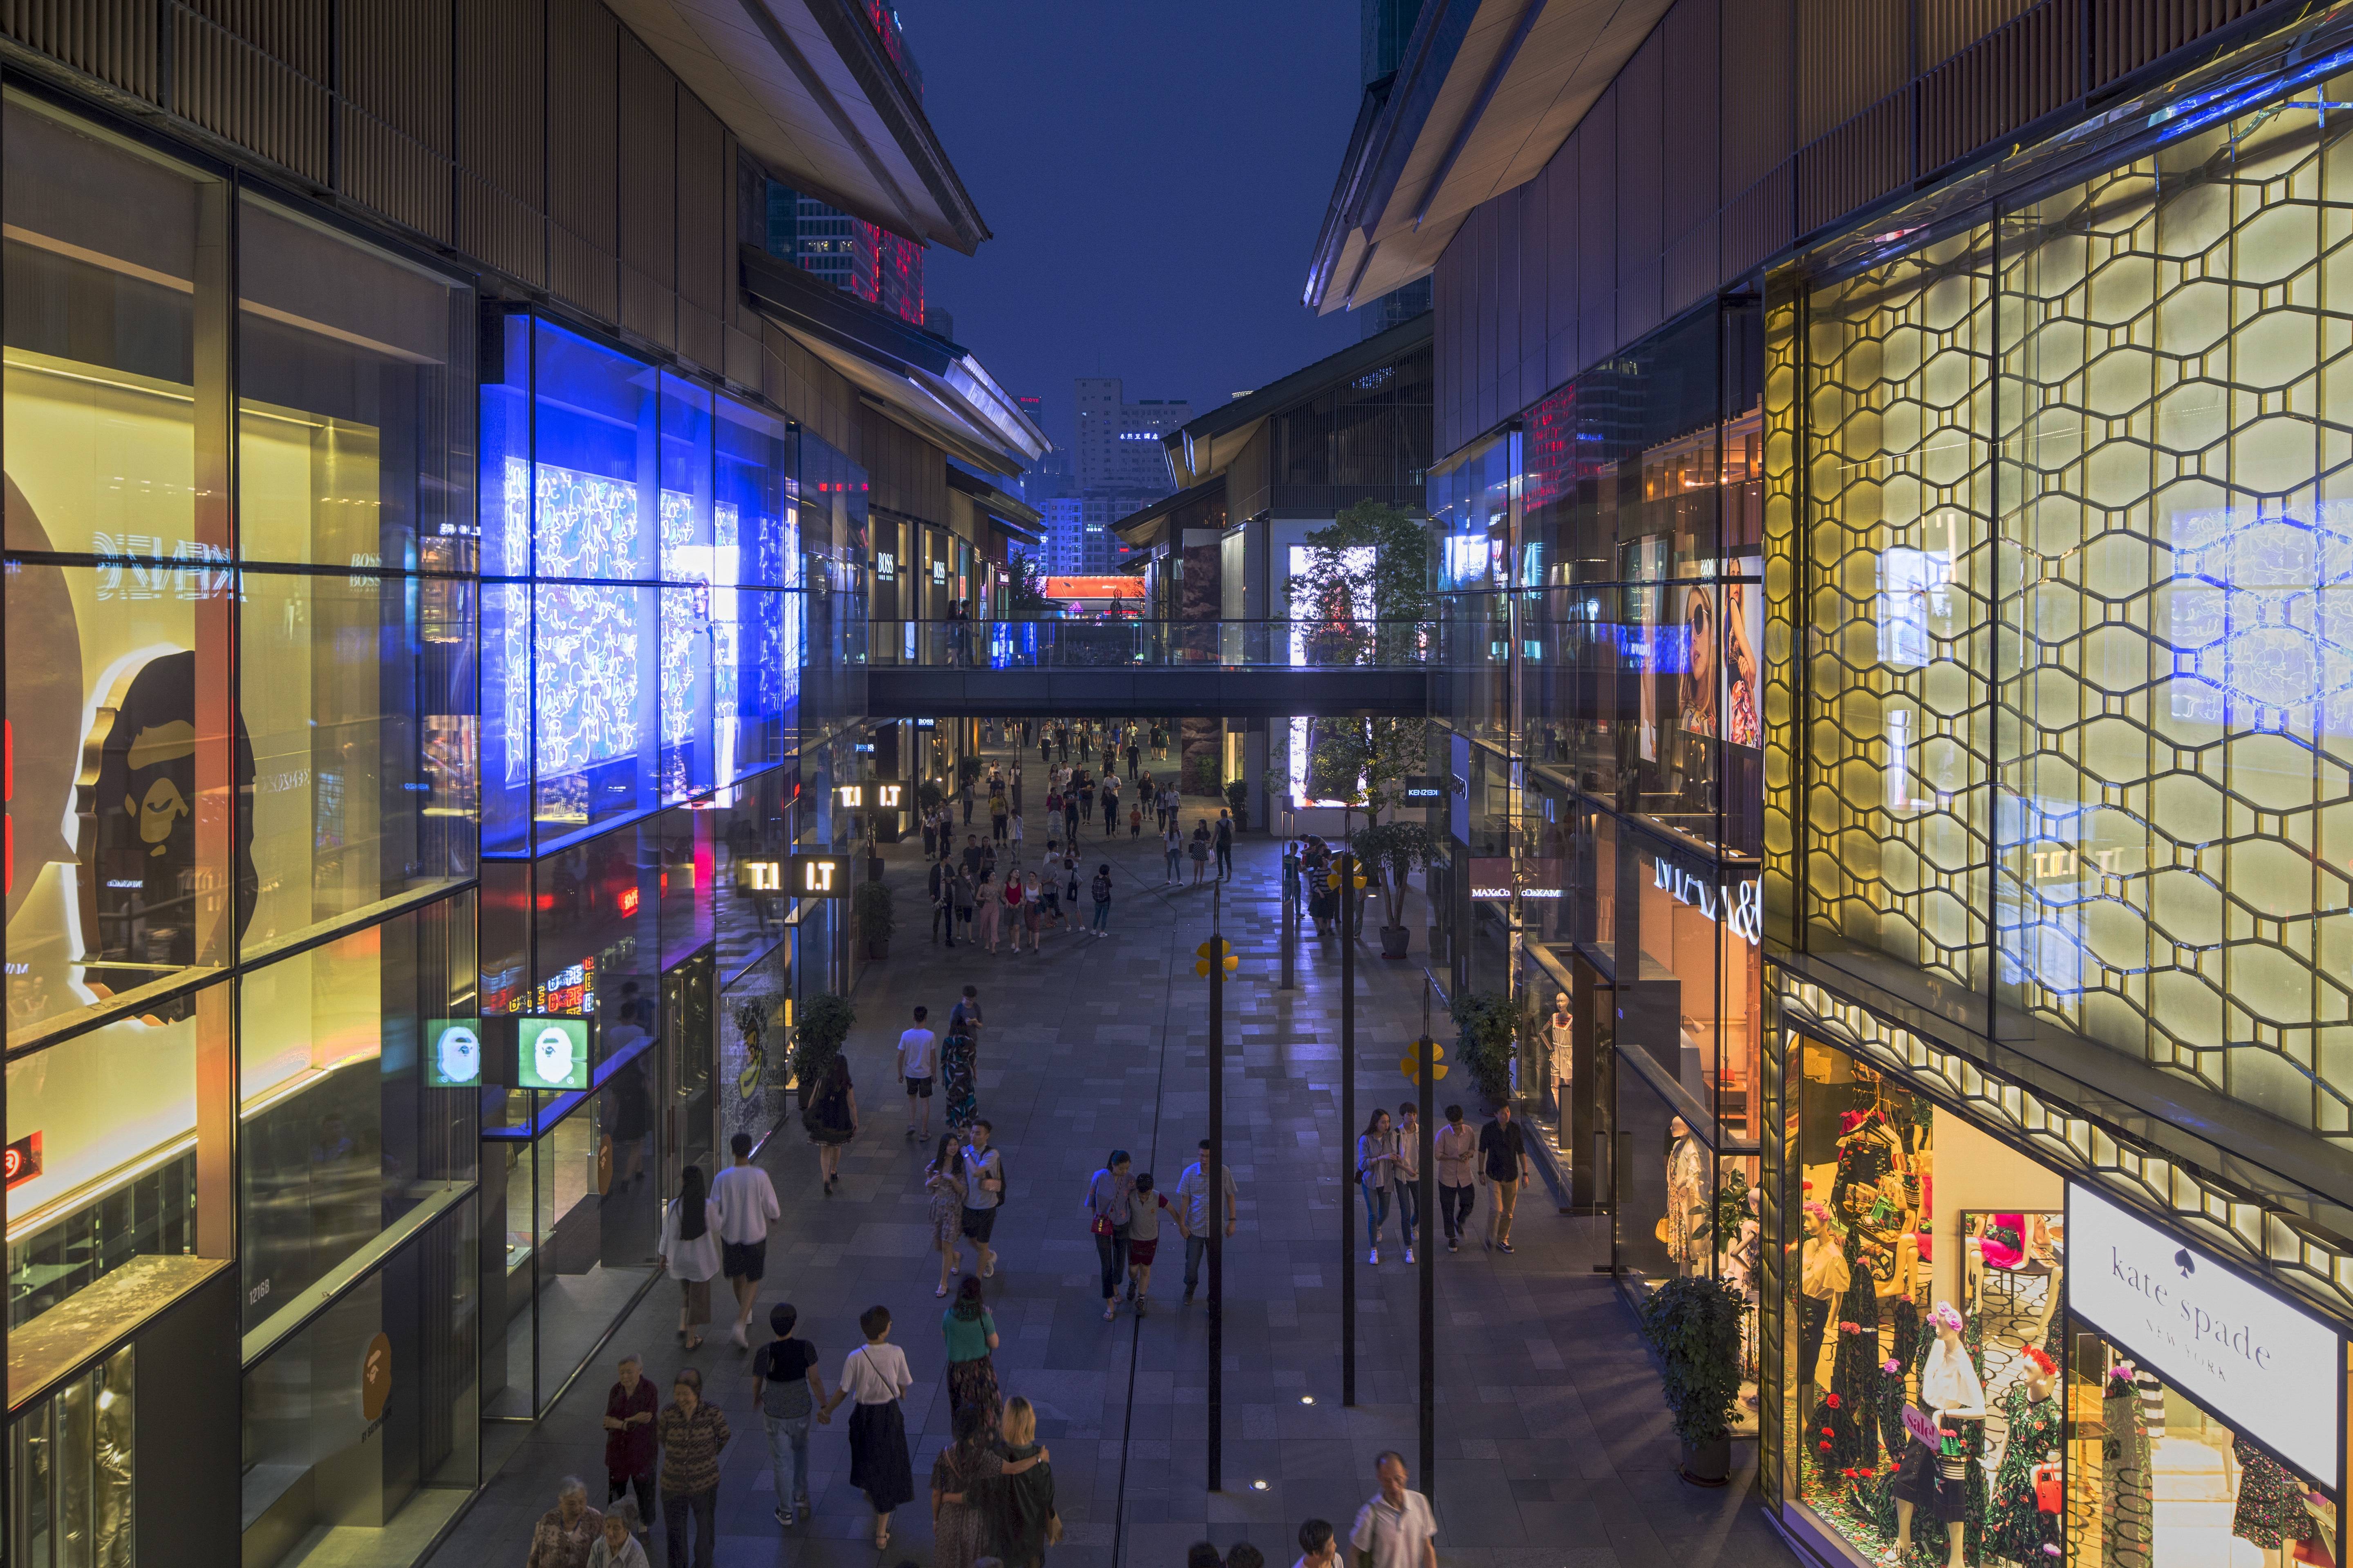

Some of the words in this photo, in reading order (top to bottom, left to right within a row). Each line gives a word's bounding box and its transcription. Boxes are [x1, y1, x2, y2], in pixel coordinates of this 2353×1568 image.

[878, 552, 893, 573] BOSS
[934, 561, 945, 579] BOSS
[880, 786, 901, 806] I.T
[806, 862, 835, 890] I.T
[249, 1279, 269, 1305] 1216B
[2112, 1246, 2167, 1306] kate
[2181, 1300, 2270, 1370] spade
[2146, 1319, 2175, 1346] NEW
[2185, 1344, 2225, 1382] YORK
[1907, 1414, 1935, 1444] sale!
